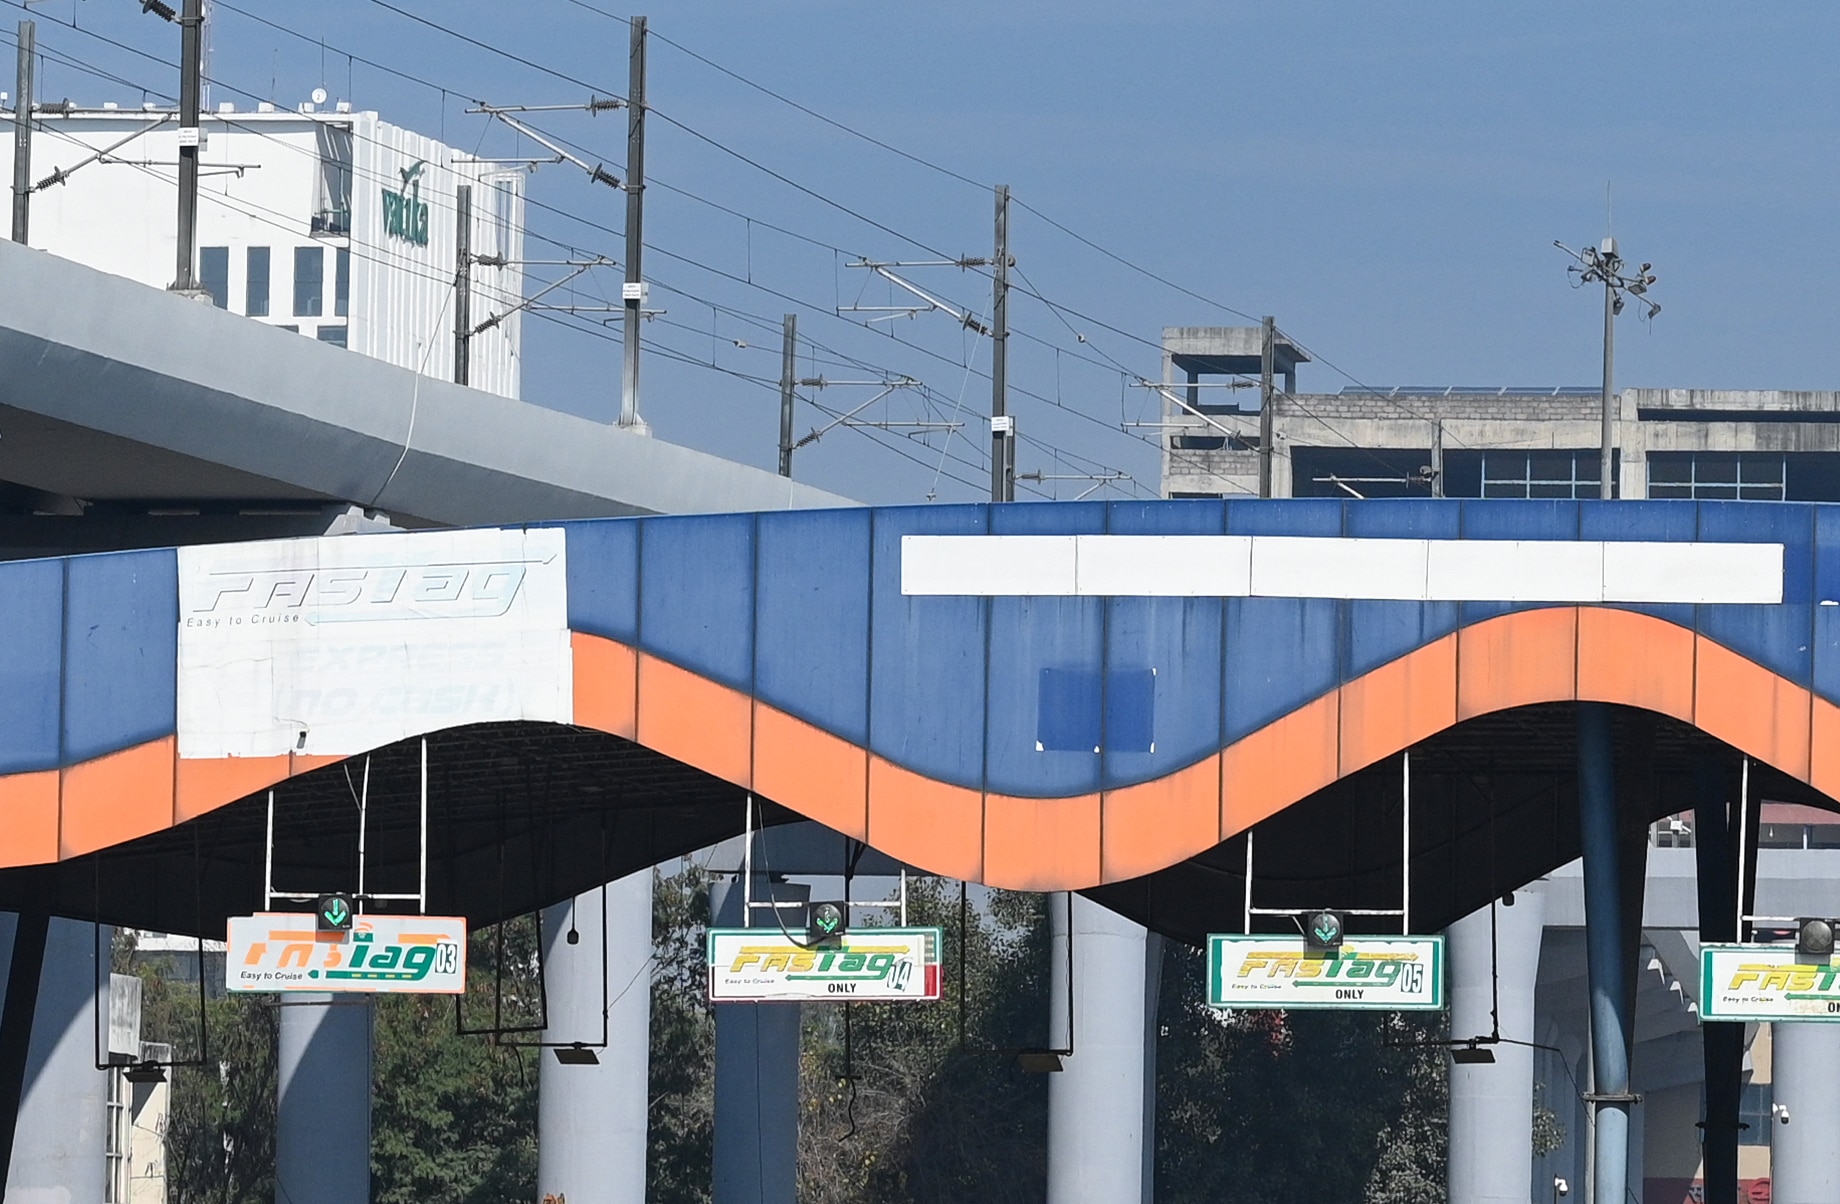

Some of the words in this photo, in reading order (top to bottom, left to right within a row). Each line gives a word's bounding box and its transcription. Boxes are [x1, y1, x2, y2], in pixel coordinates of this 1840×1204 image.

[186, 616, 221, 629] Easy
[229, 615, 243, 626] to
[251, 613, 300, 625] Cruise
[435, 943, 457, 974] 03
[240, 970, 262, 981] Easy
[264, 971, 273, 980] to
[275, 971, 303, 980] Cruise
[1402, 964, 1423, 993] 05
[827, 983, 857, 993] ONLY
[1335, 989, 1364, 999] ONLY
